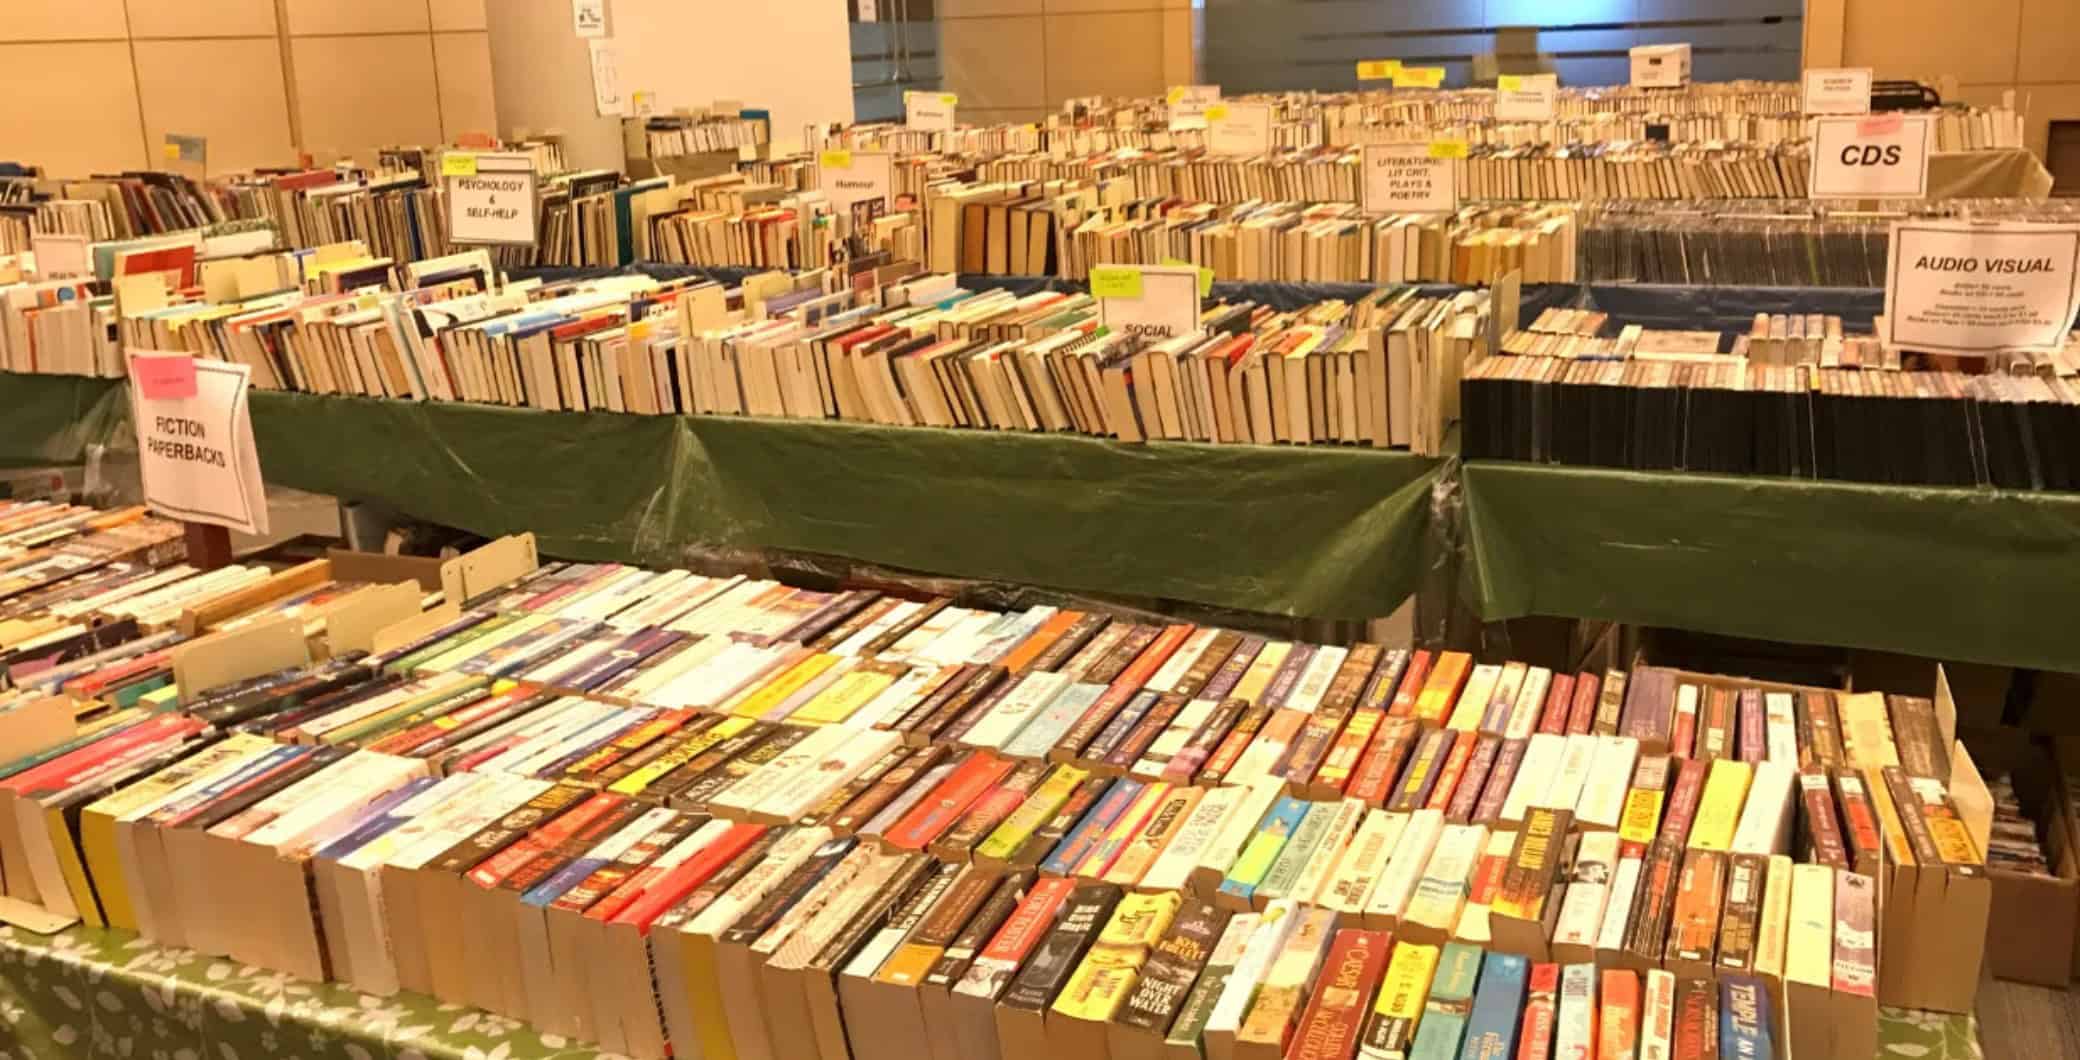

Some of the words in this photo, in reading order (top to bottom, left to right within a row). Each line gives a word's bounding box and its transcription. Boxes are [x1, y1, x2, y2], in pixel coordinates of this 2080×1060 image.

[1841, 145, 1901, 166] CDS
[459, 179, 524, 193] PSYCHOLOGY
[1390, 191, 1430, 200] POETRY
[467, 207, 518, 219] SELF-HELP
[1915, 256, 1978, 273] AUDIO
[1985, 258, 2056, 274] VISUAL
[1125, 324, 1175, 338] SOCIAL
[156, 416, 206, 438] FICTION
[147, 436, 226, 467] PAPERBACKS
[1141, 976, 1182, 995] NIGHT
[1129, 995, 1170, 1014] WATER
[1140, 988, 1171, 1004] OVER
[1729, 983, 1758, 1037] TEMPLE
